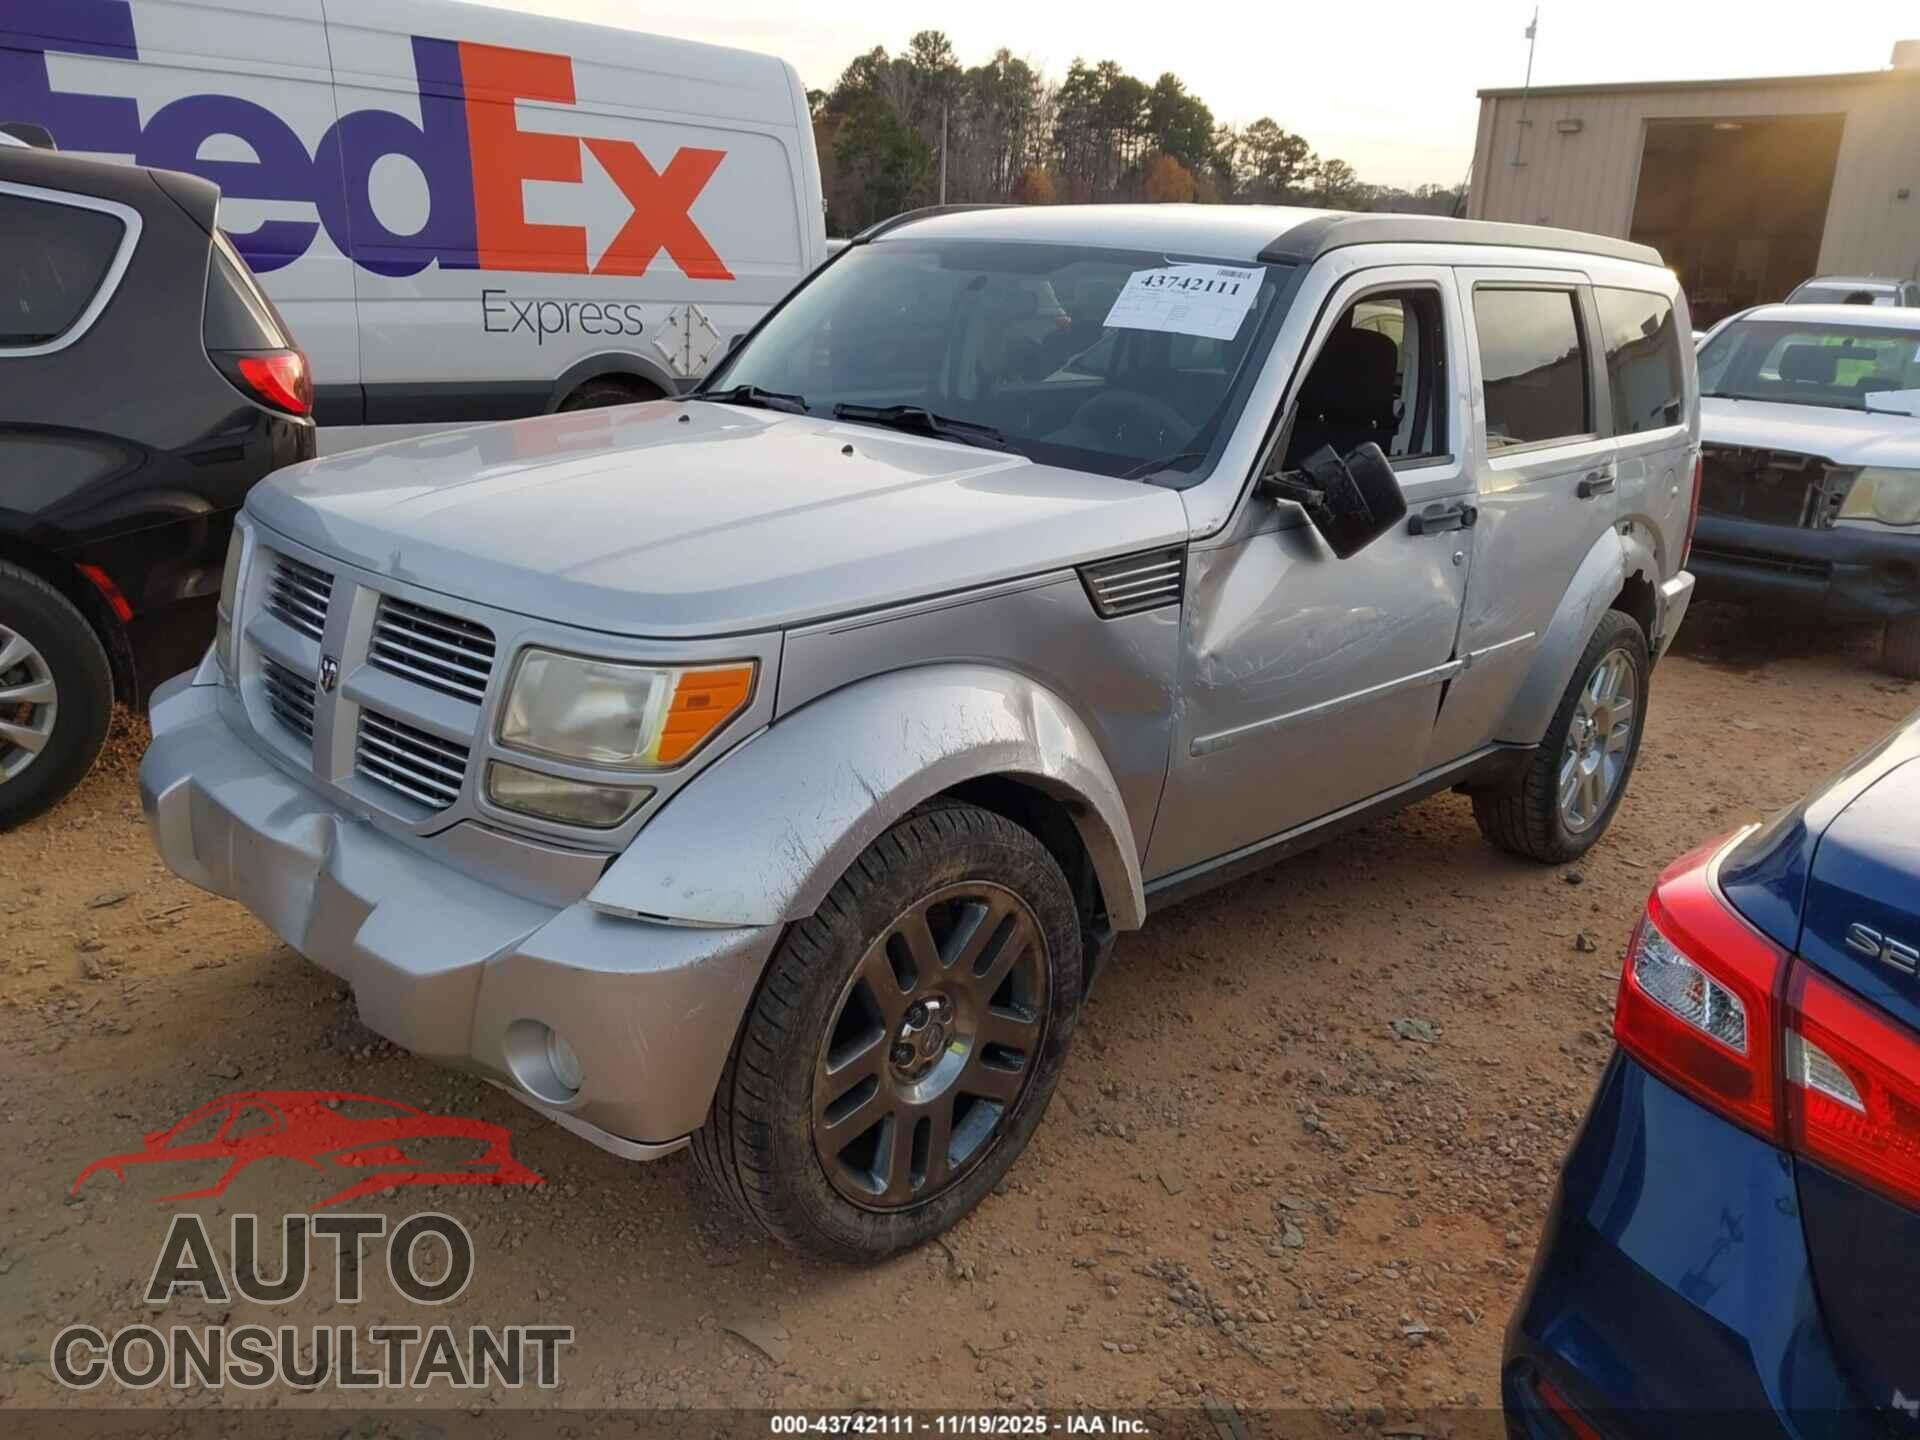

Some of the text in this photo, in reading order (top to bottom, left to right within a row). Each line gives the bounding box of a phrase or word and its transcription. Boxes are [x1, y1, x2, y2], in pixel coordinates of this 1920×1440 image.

[1141, 274, 1241, 295] 43742111
[481, 289, 643, 345] Express
[1845, 922, 1920, 977] SE
